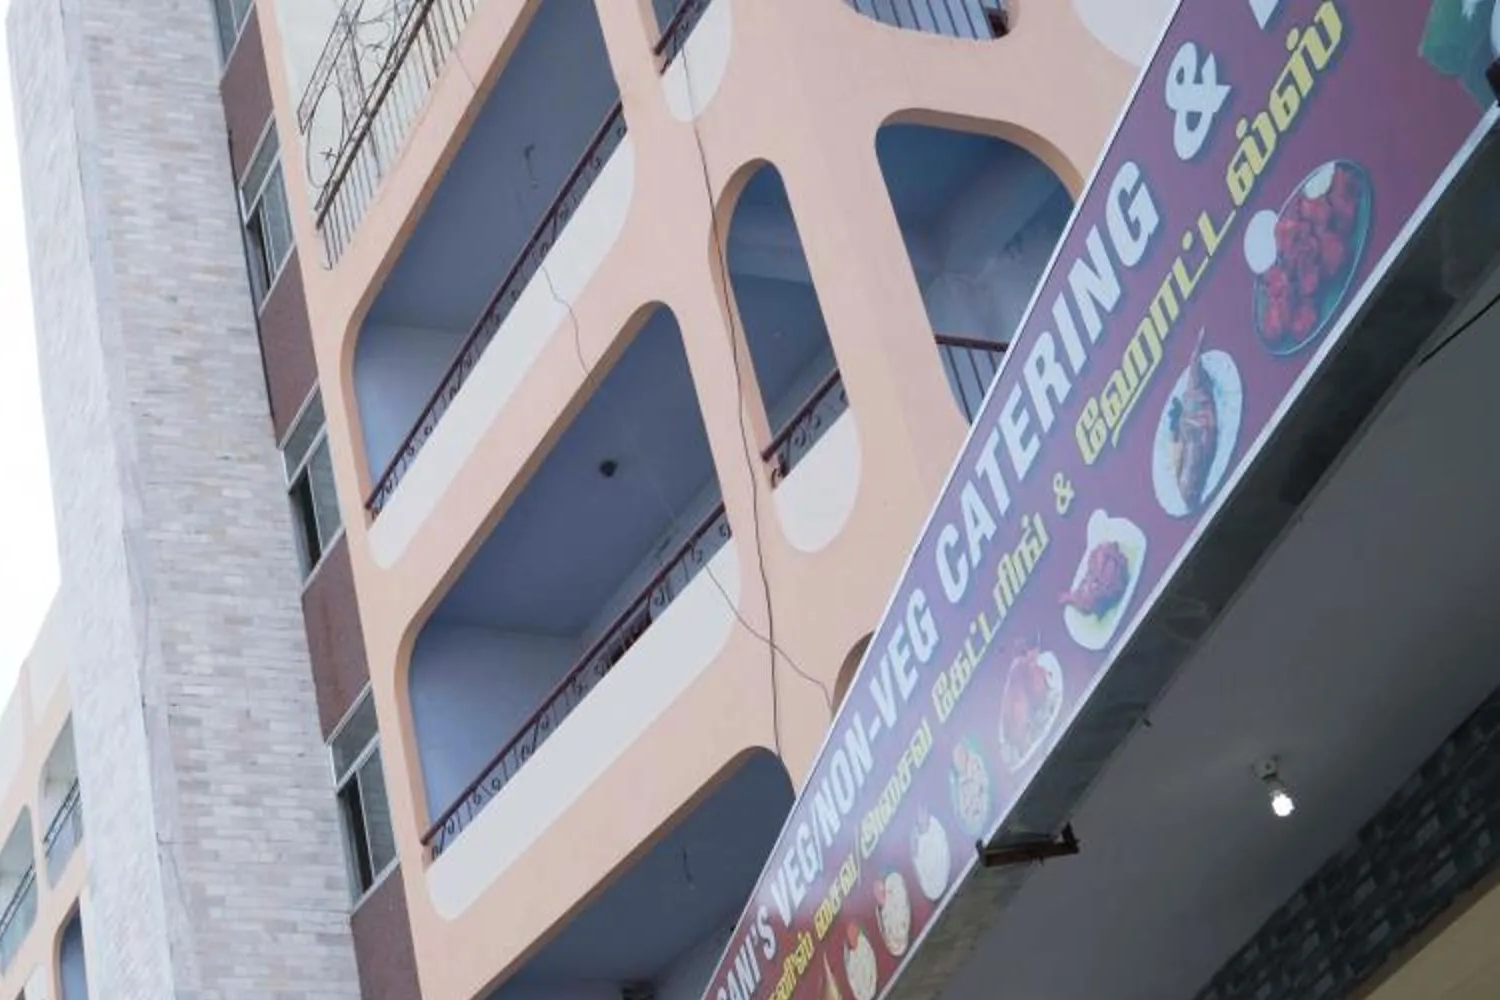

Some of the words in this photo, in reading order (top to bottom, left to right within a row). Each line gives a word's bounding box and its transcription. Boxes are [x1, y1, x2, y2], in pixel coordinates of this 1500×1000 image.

[770, 588, 940, 929] VEG/NON-VEG
[935, 161, 1160, 604] CATERING
[1165, 42, 1232, 161] &
[931, 512, 1050, 724] கேட்டரிங்
[1053, 472, 1075, 515] &
[1075, 0, 1343, 465] ஹோட்டல்ஸ்
